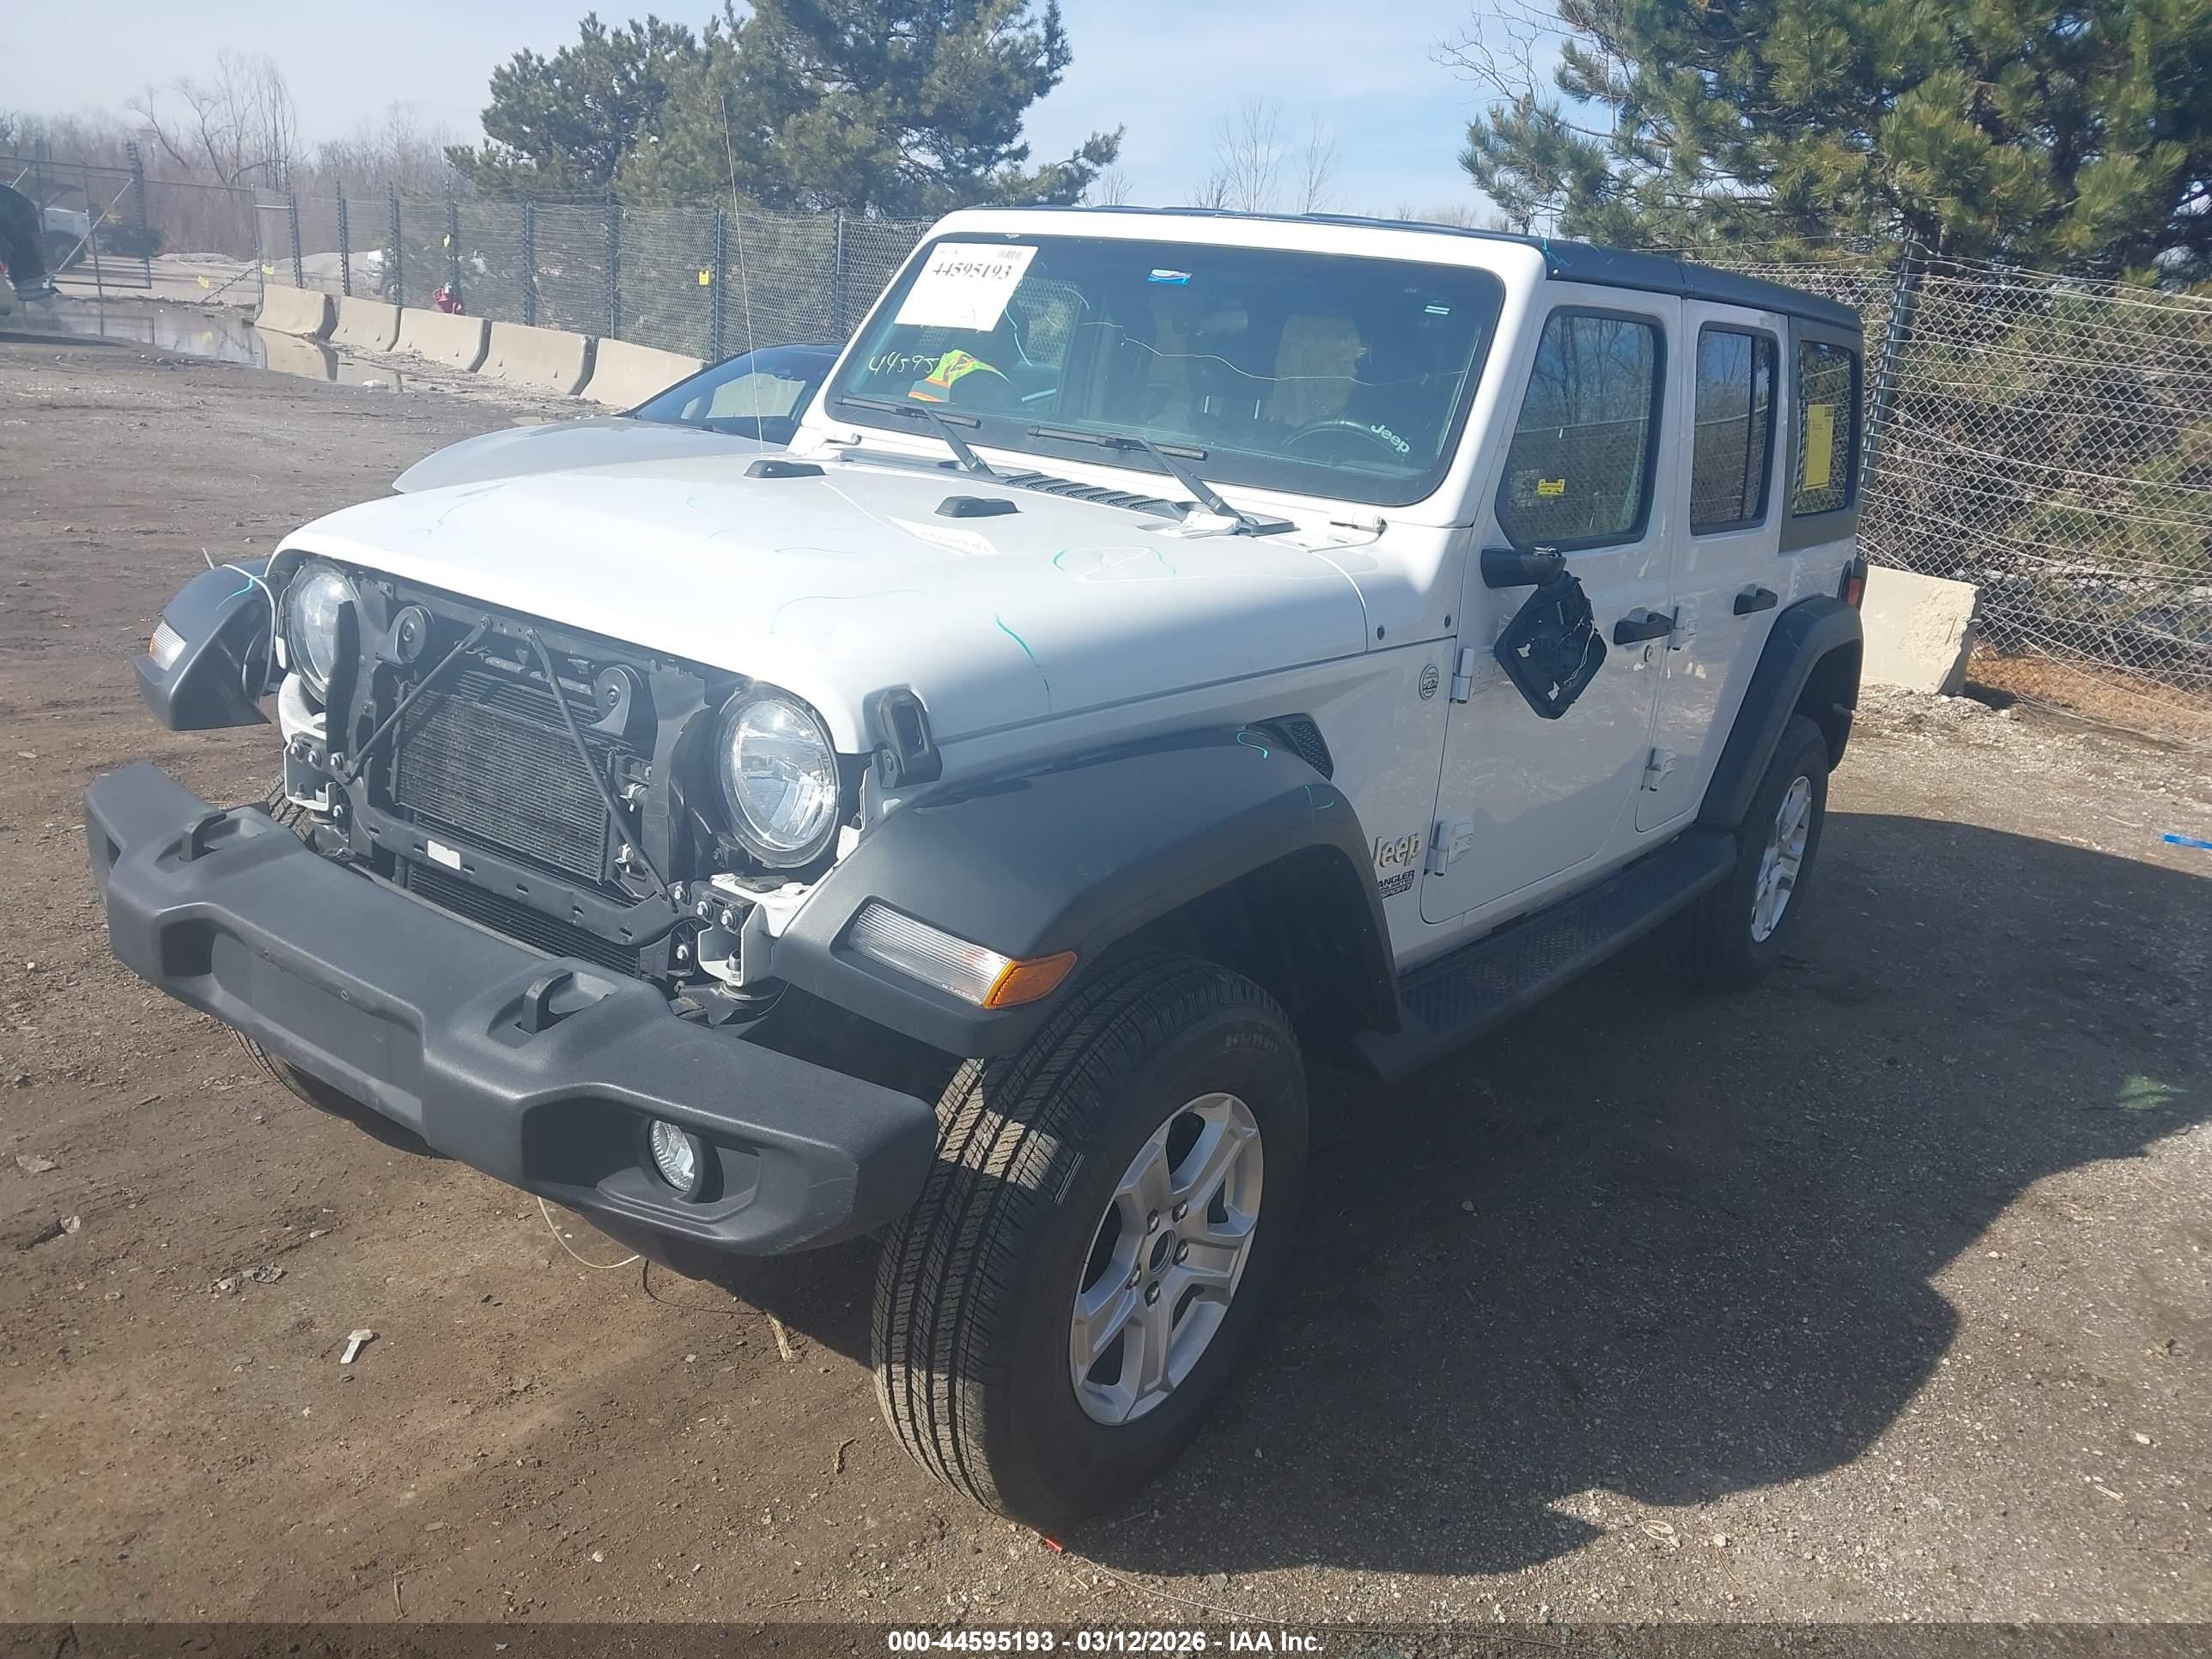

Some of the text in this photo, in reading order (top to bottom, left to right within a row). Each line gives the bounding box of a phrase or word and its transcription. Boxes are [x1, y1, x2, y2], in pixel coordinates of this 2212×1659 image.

[932, 261, 1012, 281] 44595193
[1370, 424, 1410, 453] Jeep
[1377, 869, 1415, 888] ANGLER
